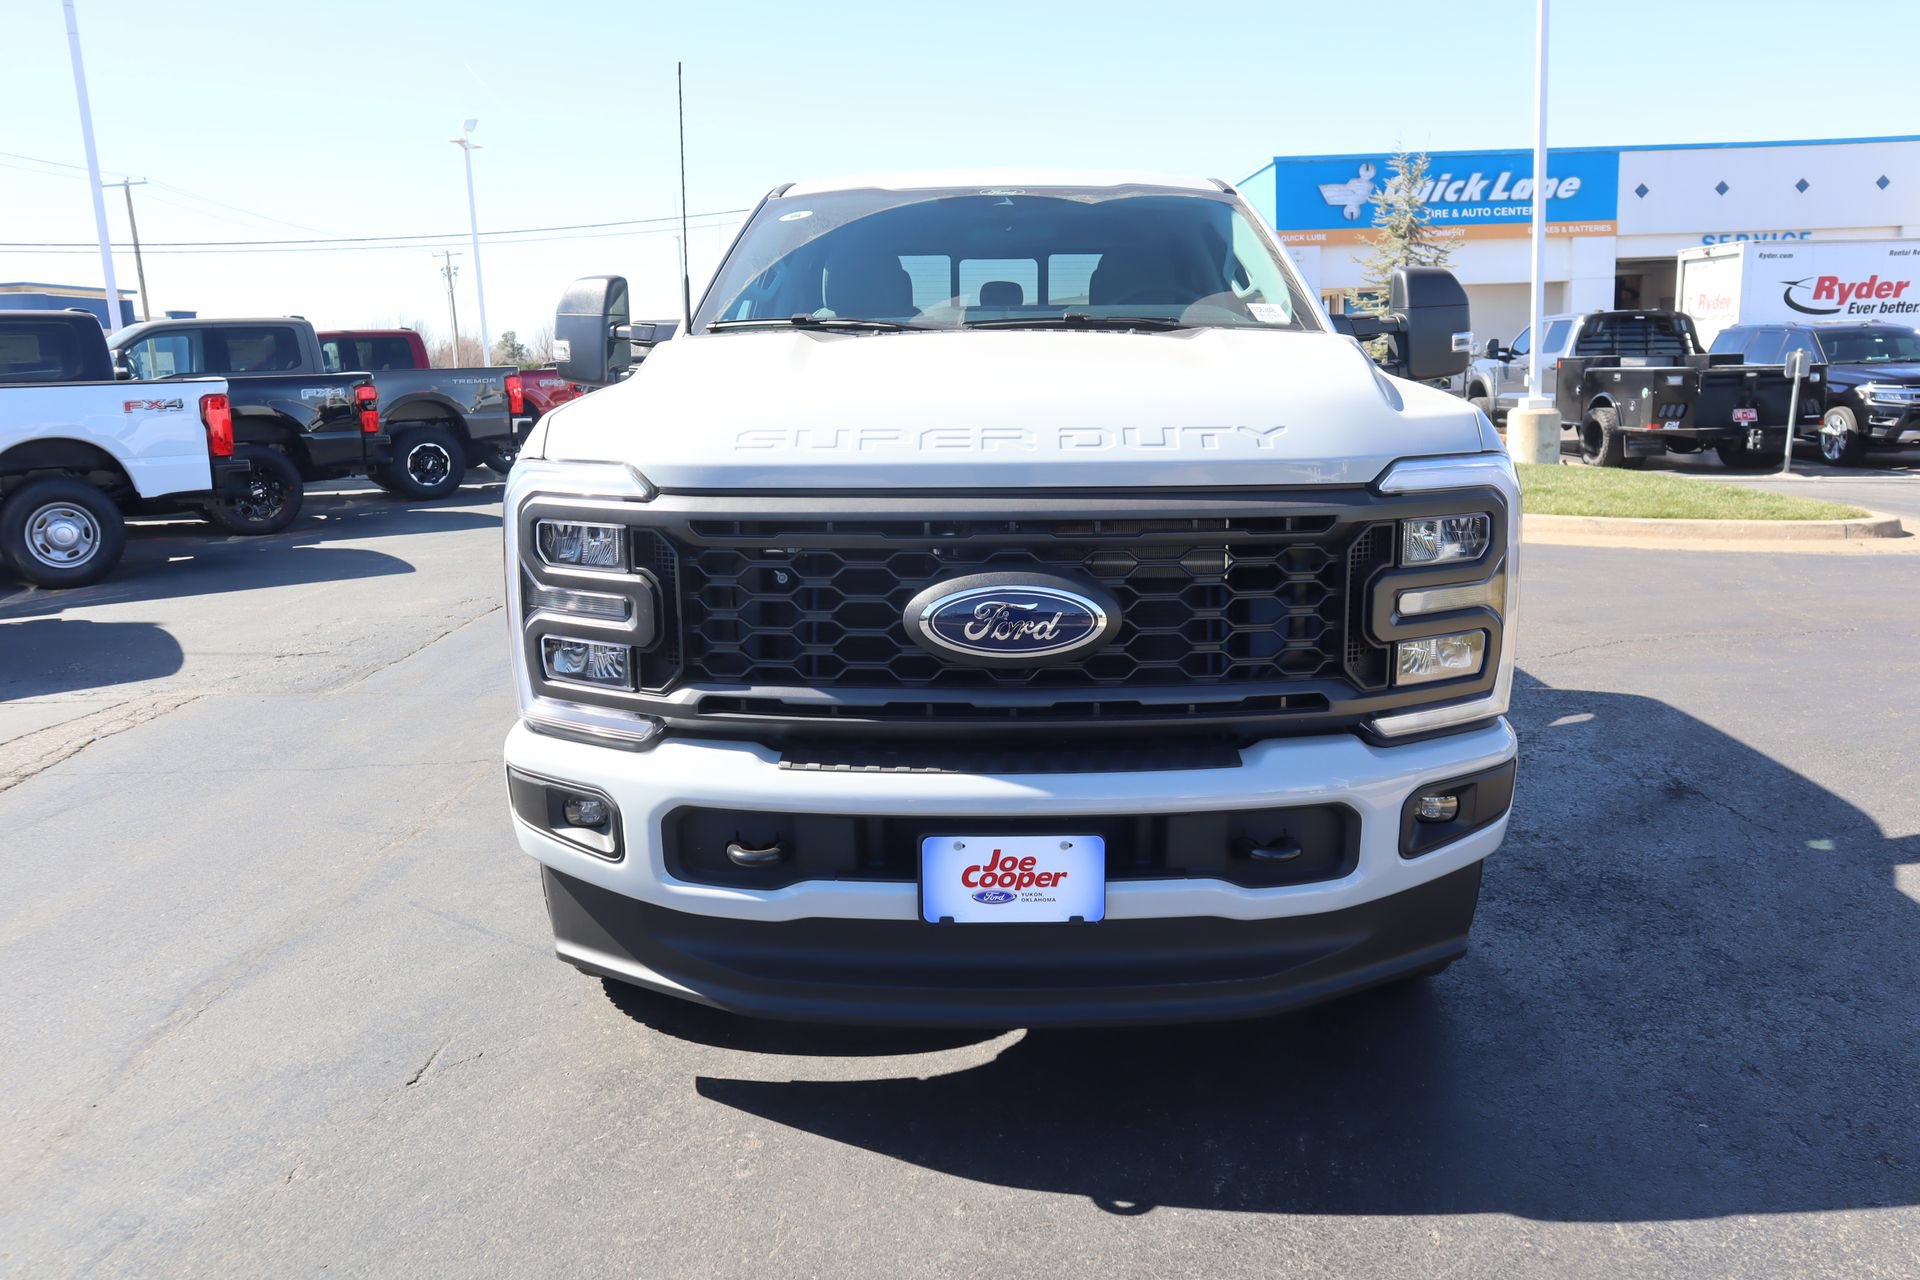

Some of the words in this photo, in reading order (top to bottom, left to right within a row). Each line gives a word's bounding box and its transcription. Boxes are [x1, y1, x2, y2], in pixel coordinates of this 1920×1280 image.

[1426, 209, 1449, 219] TIRE
[1451, 208, 1460, 218] &
[1461, 207, 1492, 217] AUTO
[1528, 225, 1560, 234] BKES
[1561, 225, 1567, 233] &
[1568, 224, 1612, 233] BATTERIES
[1281, 234, 1305, 242] QUICK
[1306, 233, 1327, 242] LUBE
[1758, 252, 1794, 260] Ryder.com
[1813, 275, 1910, 306] Ryder
[1698, 293, 1732, 312] Ryder
[1848, 302, 1877, 314] Ever
[300, 387, 346, 400] FX4
[124, 398, 184, 413] FX4
[734, 426, 1039, 452] SUPER
[1058, 425, 1289, 452] DUTY
[963, 600, 1064, 641] Ford
[982, 848, 1037, 872] Joe
[961, 865, 1068, 890] Cooper
[983, 891, 1005, 902] Ford
